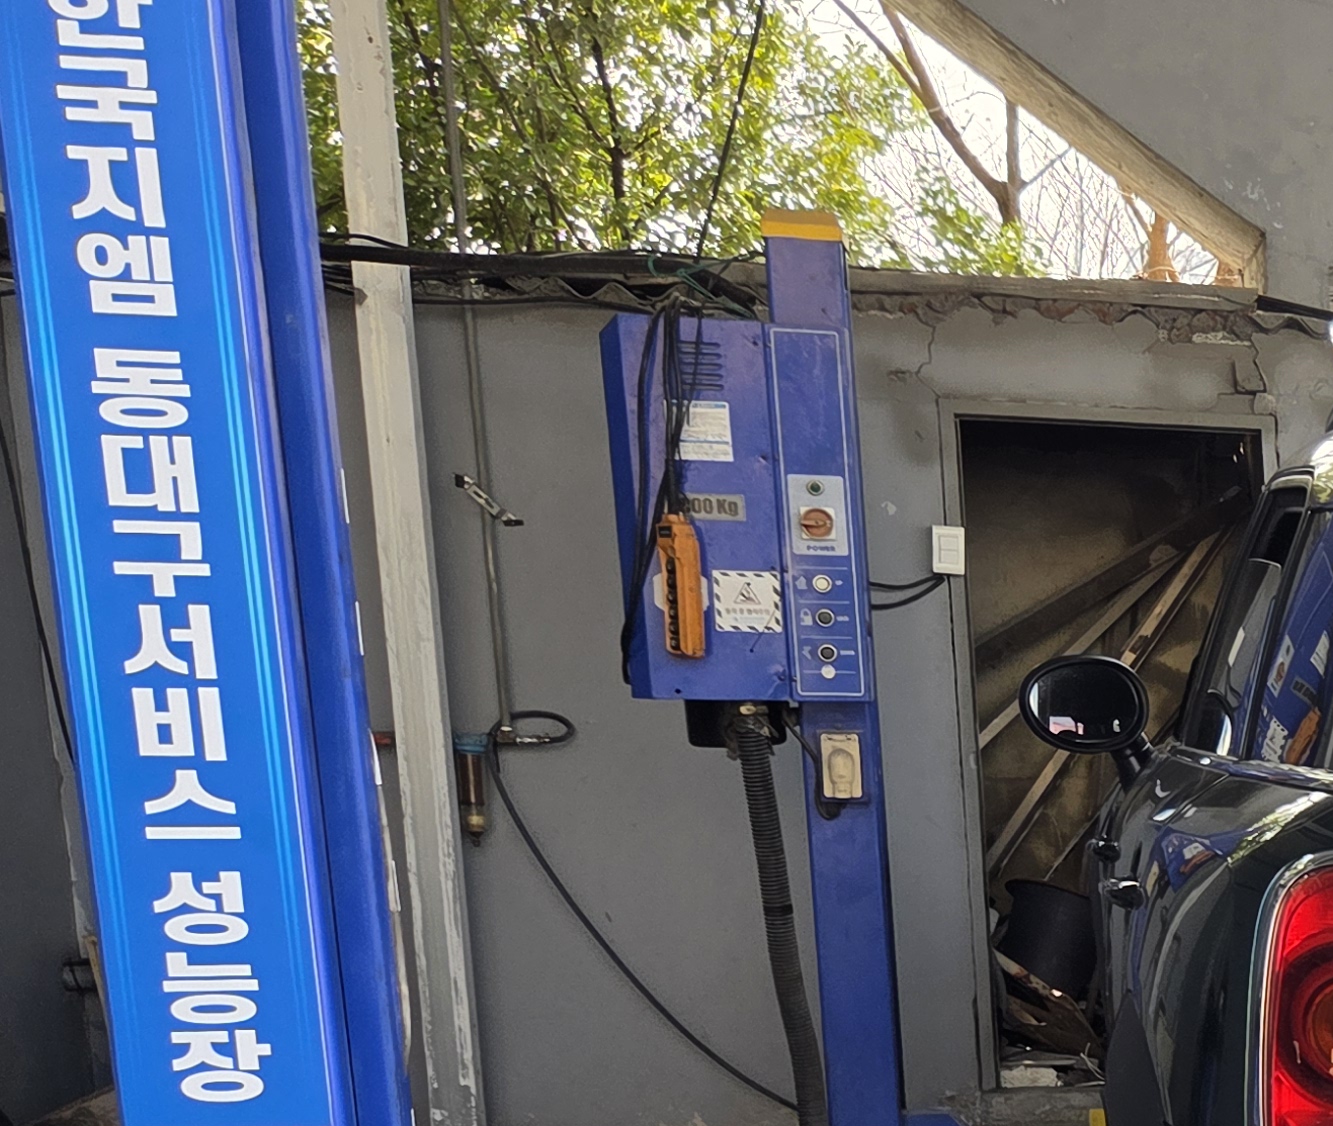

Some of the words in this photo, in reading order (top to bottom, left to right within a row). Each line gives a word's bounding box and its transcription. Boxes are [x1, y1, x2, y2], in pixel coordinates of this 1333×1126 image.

[91, 346, 242, 840] 동대구서비스
[716, 499, 739, 517] Kg
[152, 870, 272, 1103] 성능장
